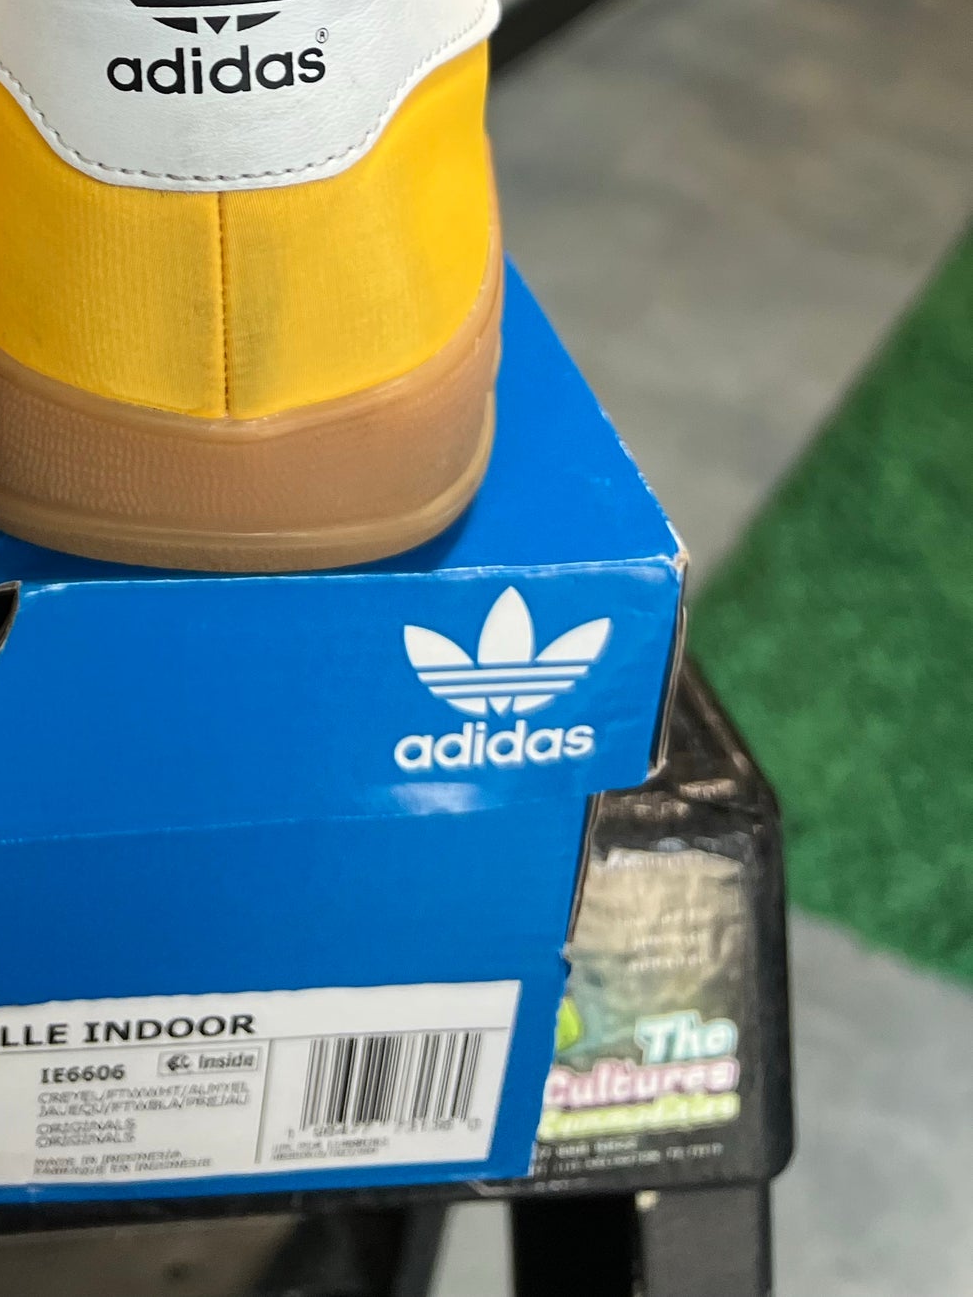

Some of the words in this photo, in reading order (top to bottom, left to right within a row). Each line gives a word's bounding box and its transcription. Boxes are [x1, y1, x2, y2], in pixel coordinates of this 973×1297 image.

[106, 44, 326, 95] adidas
[393, 718, 596, 771] adidas
[83, 1013, 256, 1044] INDOOR
[637, 1012, 736, 1064] The
[41, 1064, 126, 1085] IE6606
